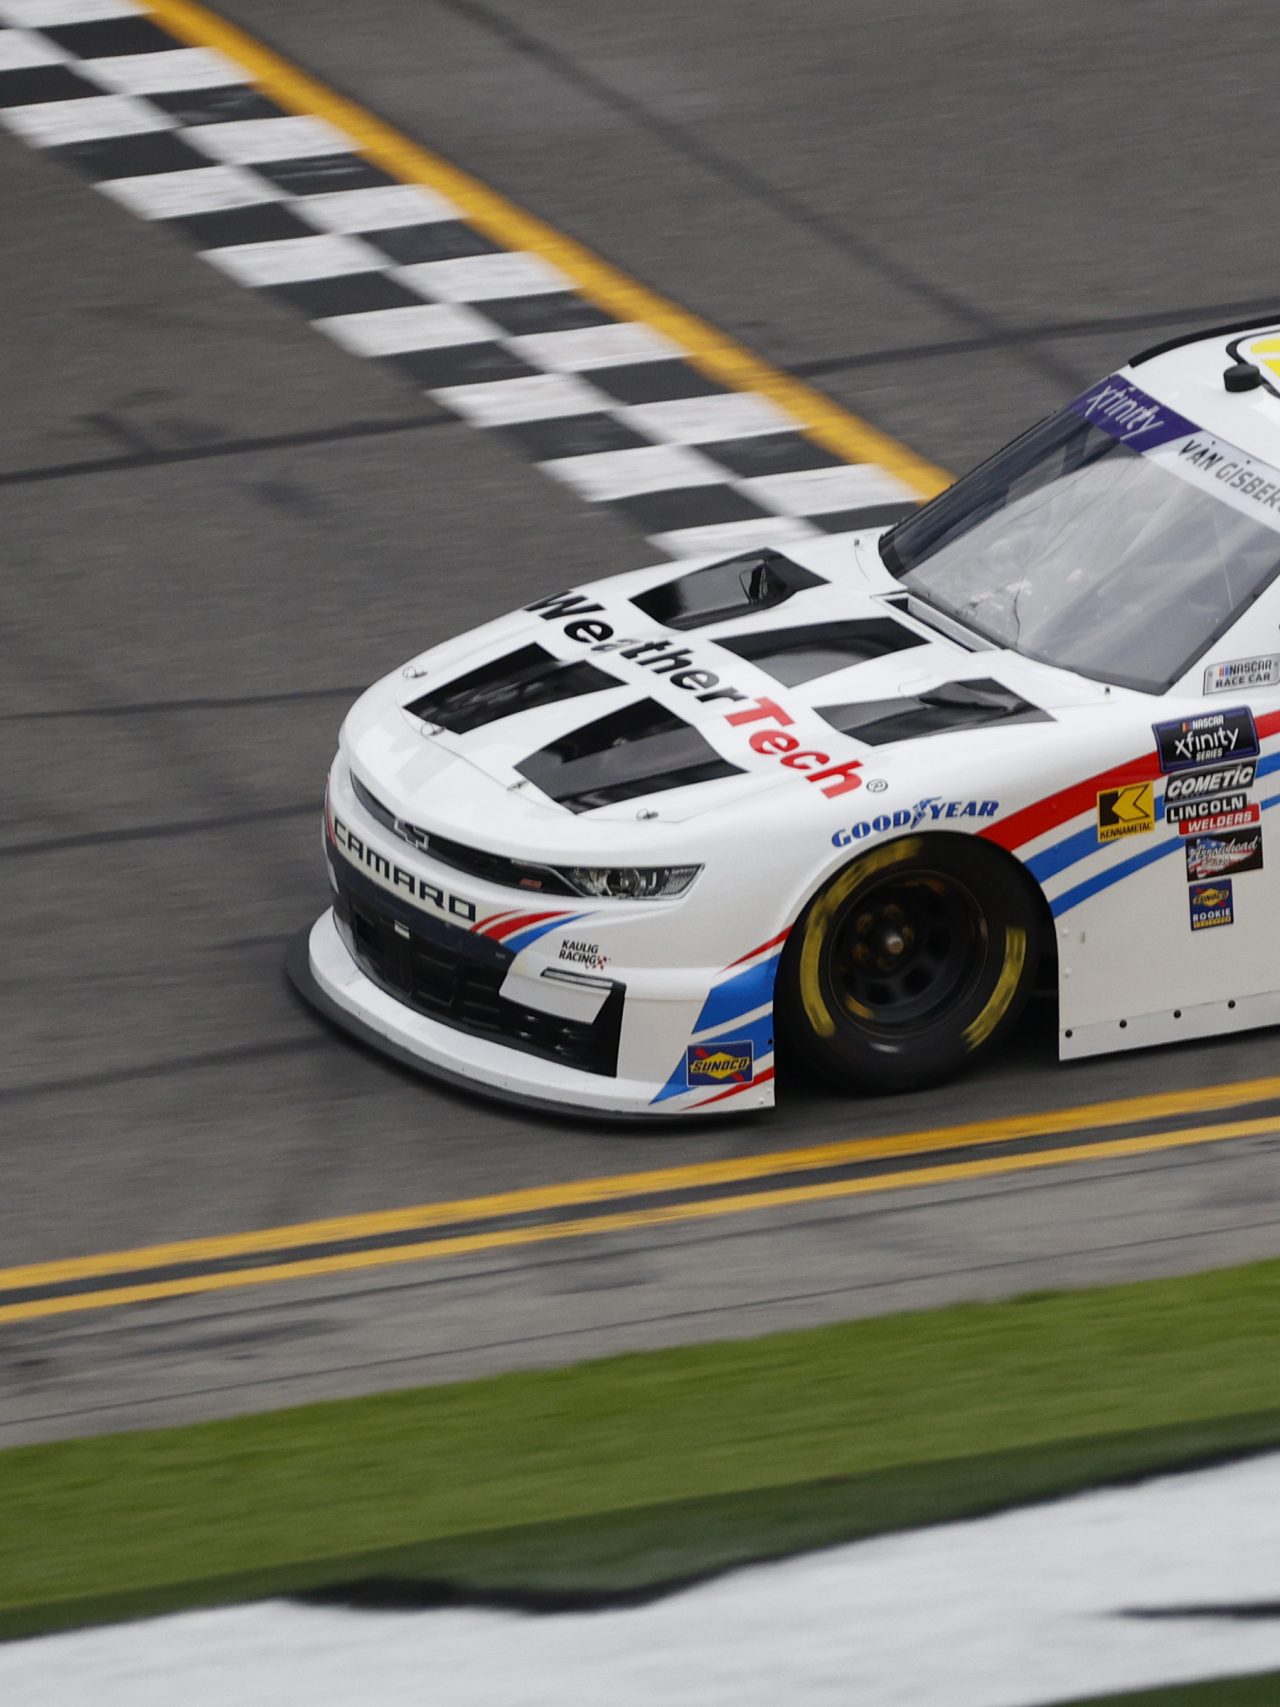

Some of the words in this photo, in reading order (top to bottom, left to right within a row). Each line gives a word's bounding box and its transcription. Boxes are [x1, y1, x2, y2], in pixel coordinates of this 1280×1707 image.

[1086, 384, 1165, 441] xfinity
[1178, 439, 1224, 471] VAN
[1229, 660, 1272, 676] NASCAR
[1215, 676, 1245, 689] RACE
[1248, 673, 1272, 685] CAR
[1192, 714, 1224, 730] NASCAR
[1174, 727, 1239, 760] xfinity
[1196, 747, 1223, 762] SERIES
[1167, 764, 1254, 799] COMETIC
[1170, 795, 1244, 823] LINCOLN
[831, 797, 999, 848] GOODYEAR
[1100, 821, 1154, 840] KENNAMETAL
[1188, 810, 1252, 834] WELDERS
[334, 816, 476, 923] CAMARO
[1193, 889, 1229, 904] SUNOCO
[1192, 907, 1231, 922] ROOKIE
[562, 939, 599, 954] KAULIG
[559, 949, 597, 966] RACING
[690, 1056, 750, 1075] SUNOCO
